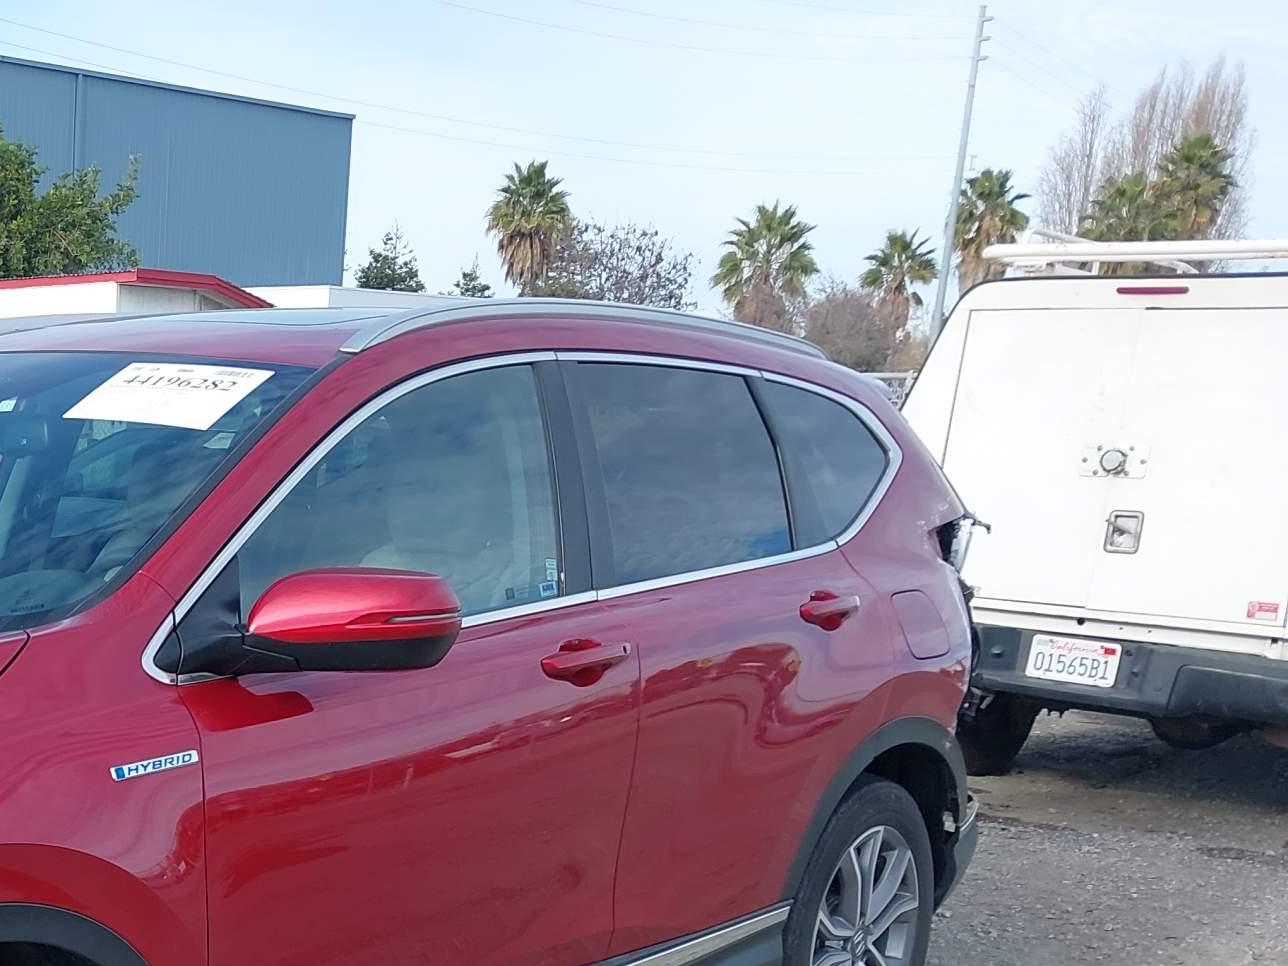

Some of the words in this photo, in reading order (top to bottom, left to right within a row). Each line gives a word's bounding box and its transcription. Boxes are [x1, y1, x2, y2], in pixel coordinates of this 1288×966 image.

[123, 374, 238, 392] 44196282
[1033, 651, 1109, 680] 01565B1
[128, 753, 192, 776] HYBRID
